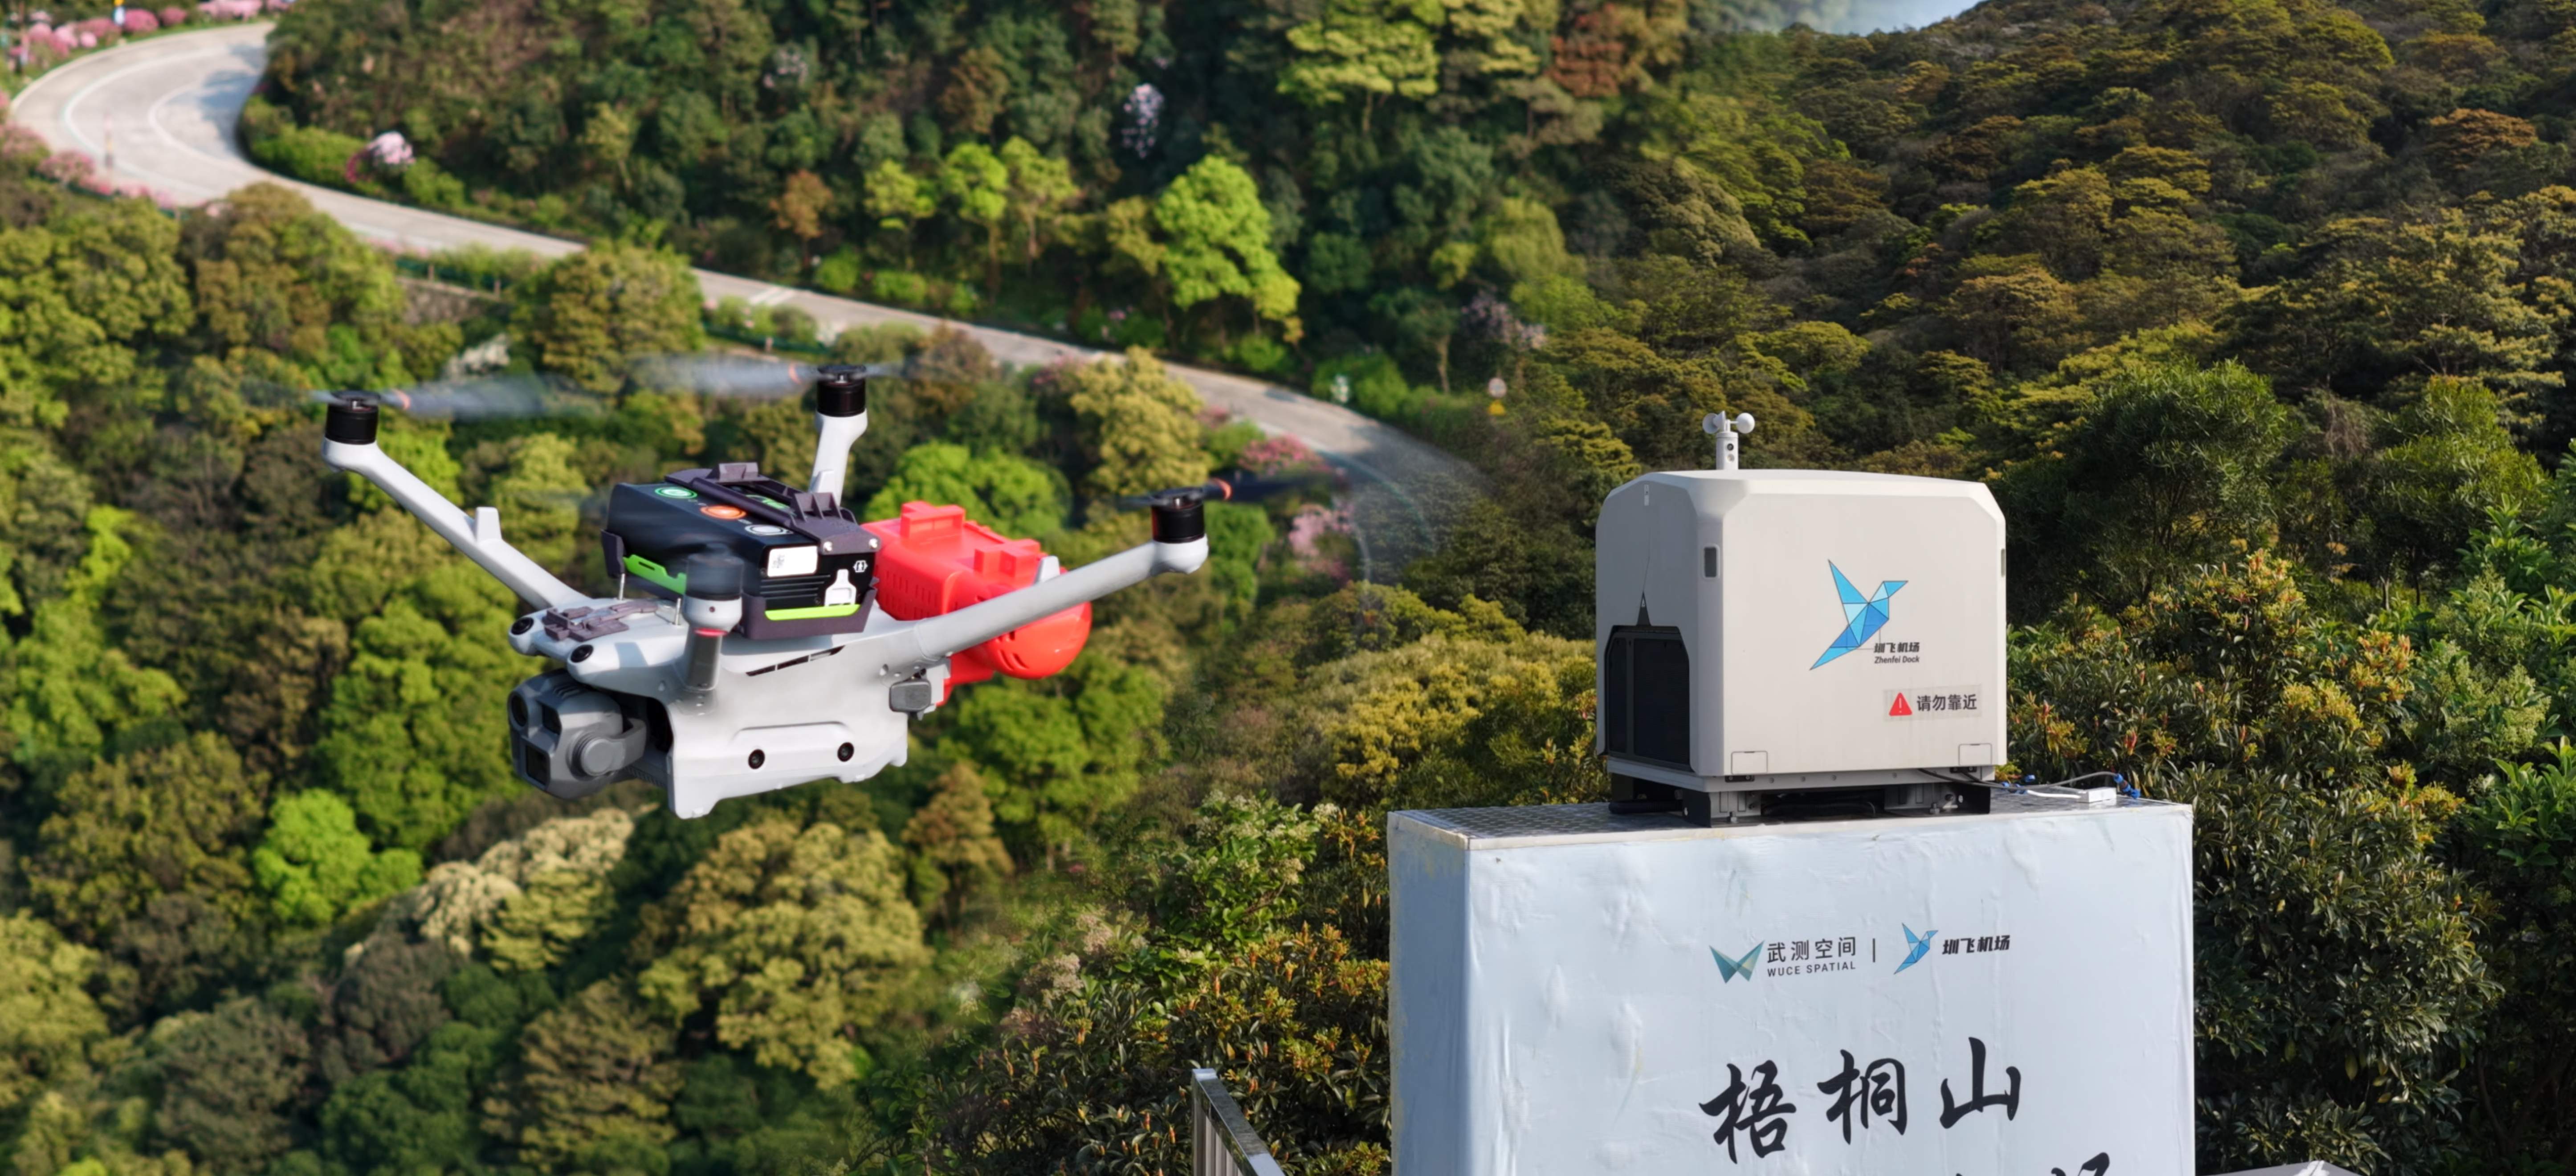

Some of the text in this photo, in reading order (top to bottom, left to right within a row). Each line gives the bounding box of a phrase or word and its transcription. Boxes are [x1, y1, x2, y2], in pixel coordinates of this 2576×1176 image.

[1873, 641, 1920, 653] 圳飞机场
[1874, 655, 1920, 664] Zhenfei Dock
[1916, 694, 1977, 711] 请勿靠近
[1767, 936, 1856, 964] 武测空间
[1942, 935, 2010, 955] 圳飞机场
[1767, 961, 1856, 977] WUCE SPATIAL
[1698, 1037, 2022, 1164] 梧桐山
